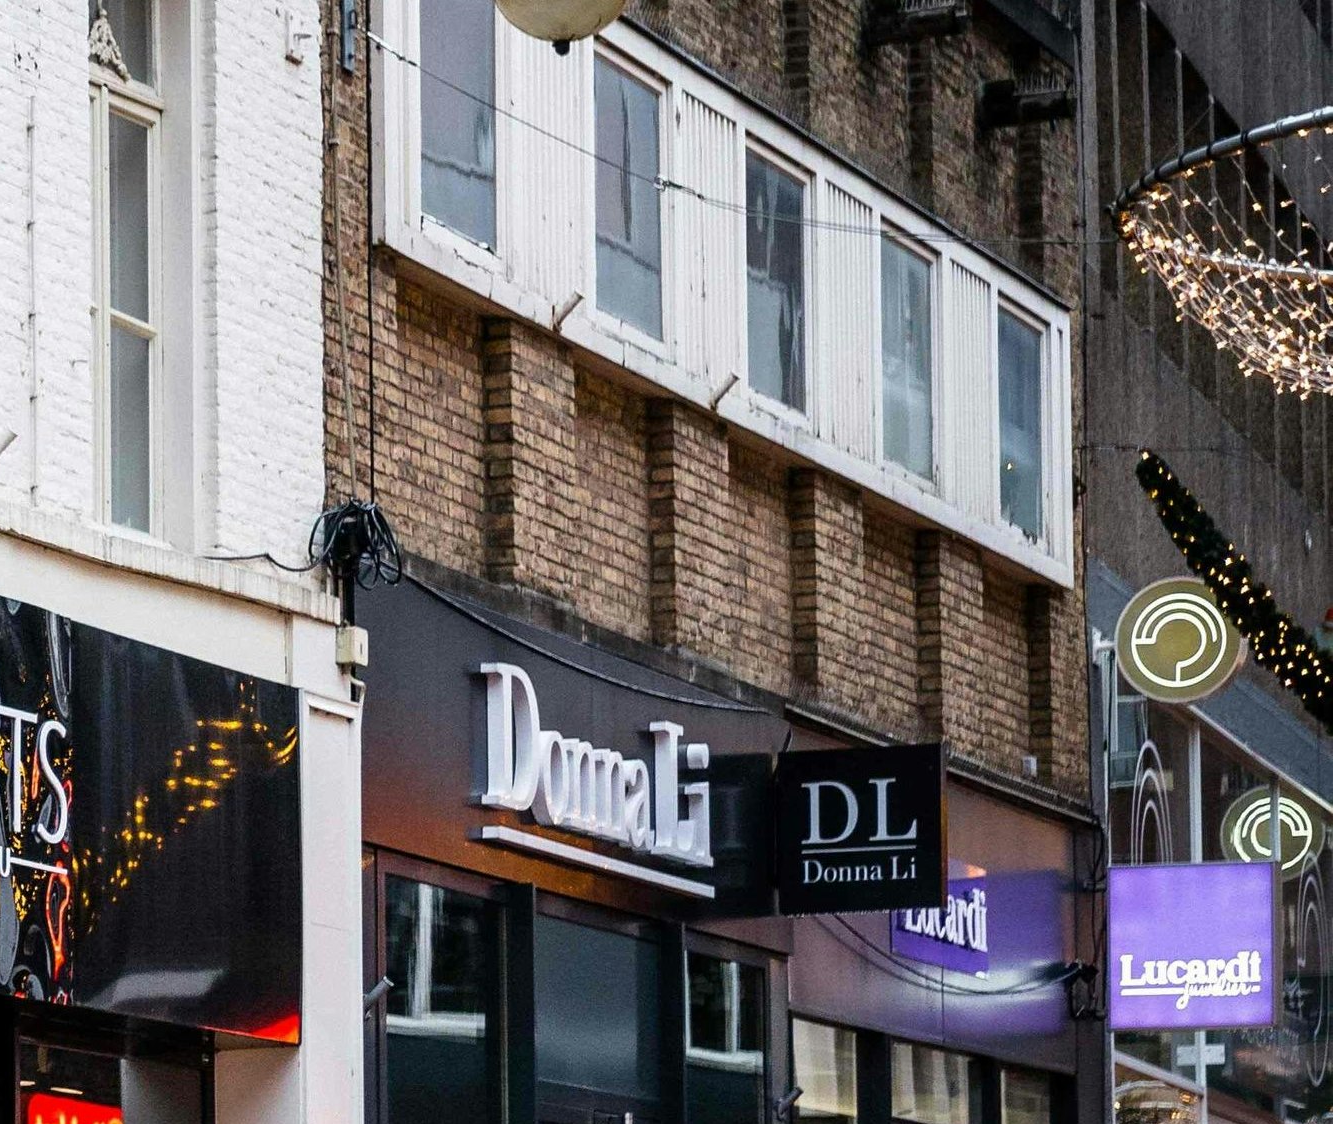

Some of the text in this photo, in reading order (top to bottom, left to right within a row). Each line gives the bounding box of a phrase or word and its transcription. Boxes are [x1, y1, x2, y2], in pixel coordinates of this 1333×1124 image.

[801, 777, 917, 845] DL
[803, 855, 916, 884] Donna Li
[1119, 950, 1262, 986] Lucardi
